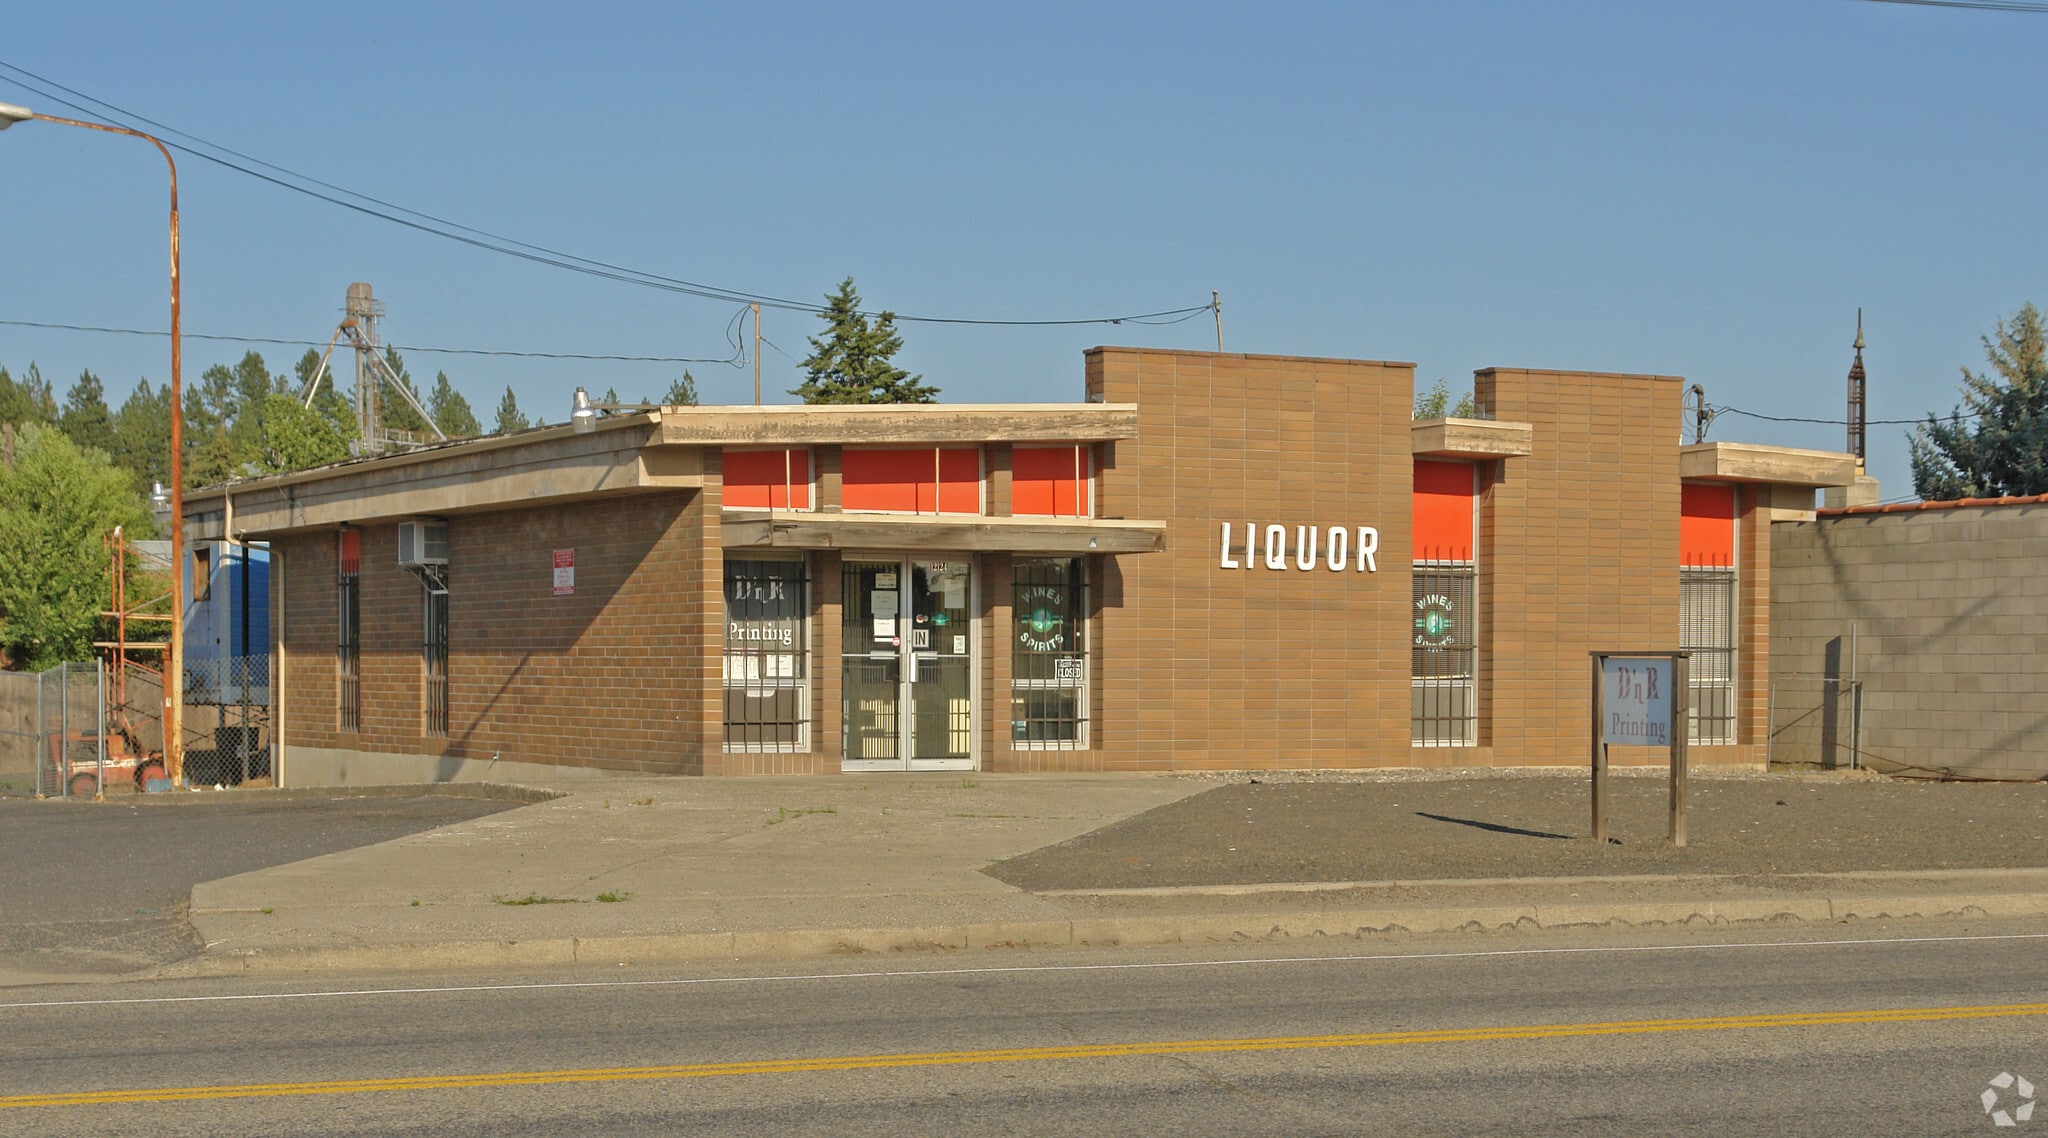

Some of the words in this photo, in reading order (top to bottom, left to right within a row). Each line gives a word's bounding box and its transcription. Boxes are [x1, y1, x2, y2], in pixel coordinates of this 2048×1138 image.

[1220, 522, 1378, 572] LIQUOR
[1021, 587, 1063, 605] WINES
[1416, 594, 1453, 611] WINES
[728, 622, 792, 645] Printing
[915, 631, 926, 645] IN
[1020, 632, 1064, 652] SPIRITS
[1611, 712, 1666, 744] Printing
